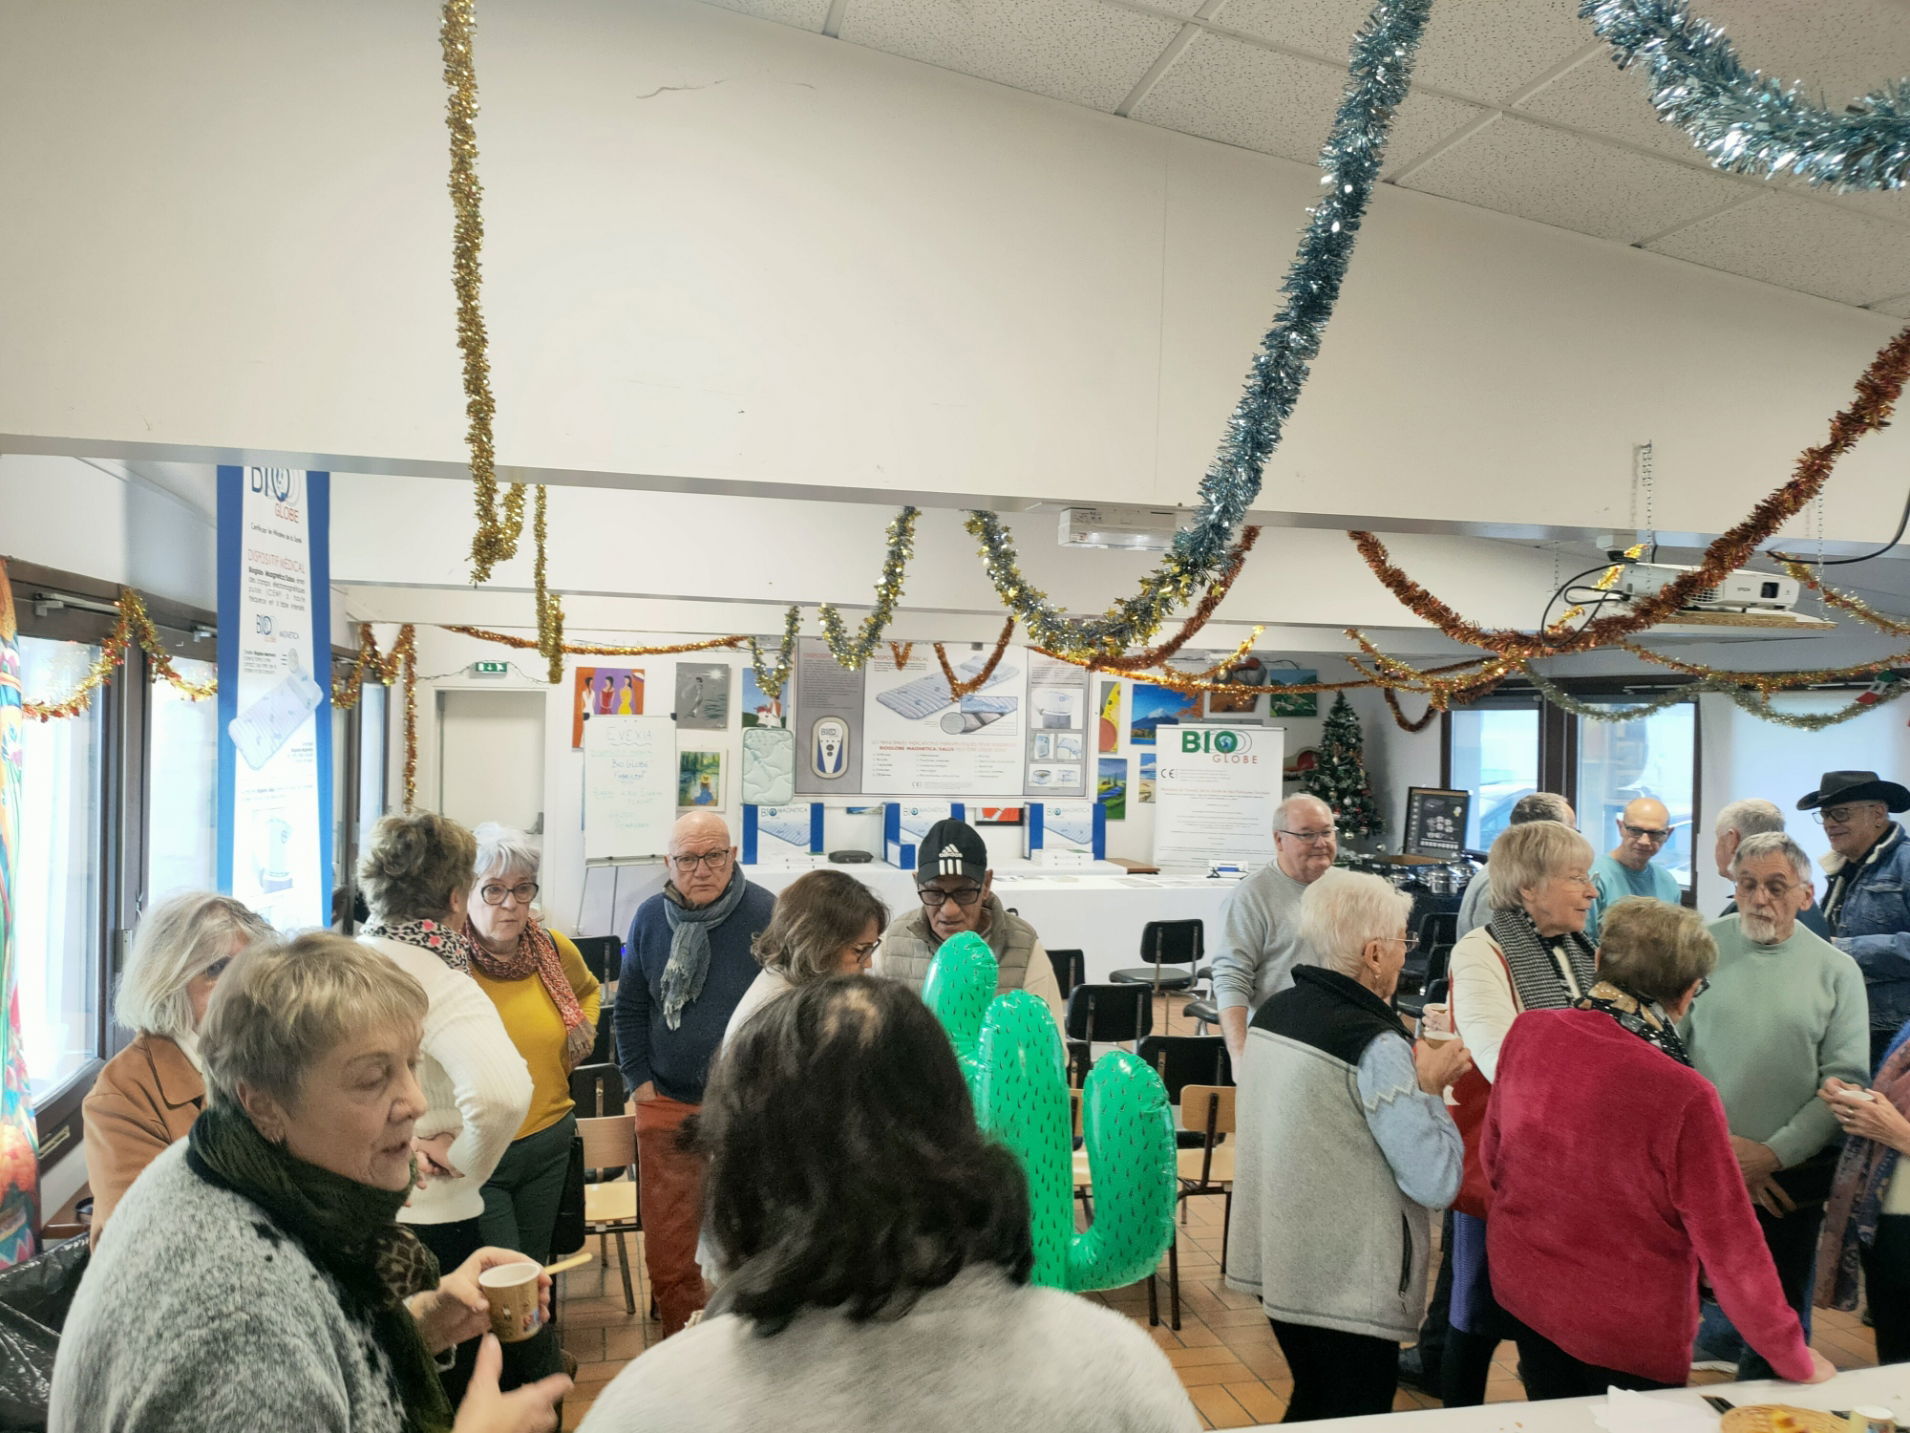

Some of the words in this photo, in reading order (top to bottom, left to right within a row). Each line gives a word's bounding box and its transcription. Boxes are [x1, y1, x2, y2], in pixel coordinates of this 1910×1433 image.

[275, 502, 299, 524] GLOBE
[1181, 730, 1238, 754] BIO
[1212, 754, 1259, 765] GLOBE
